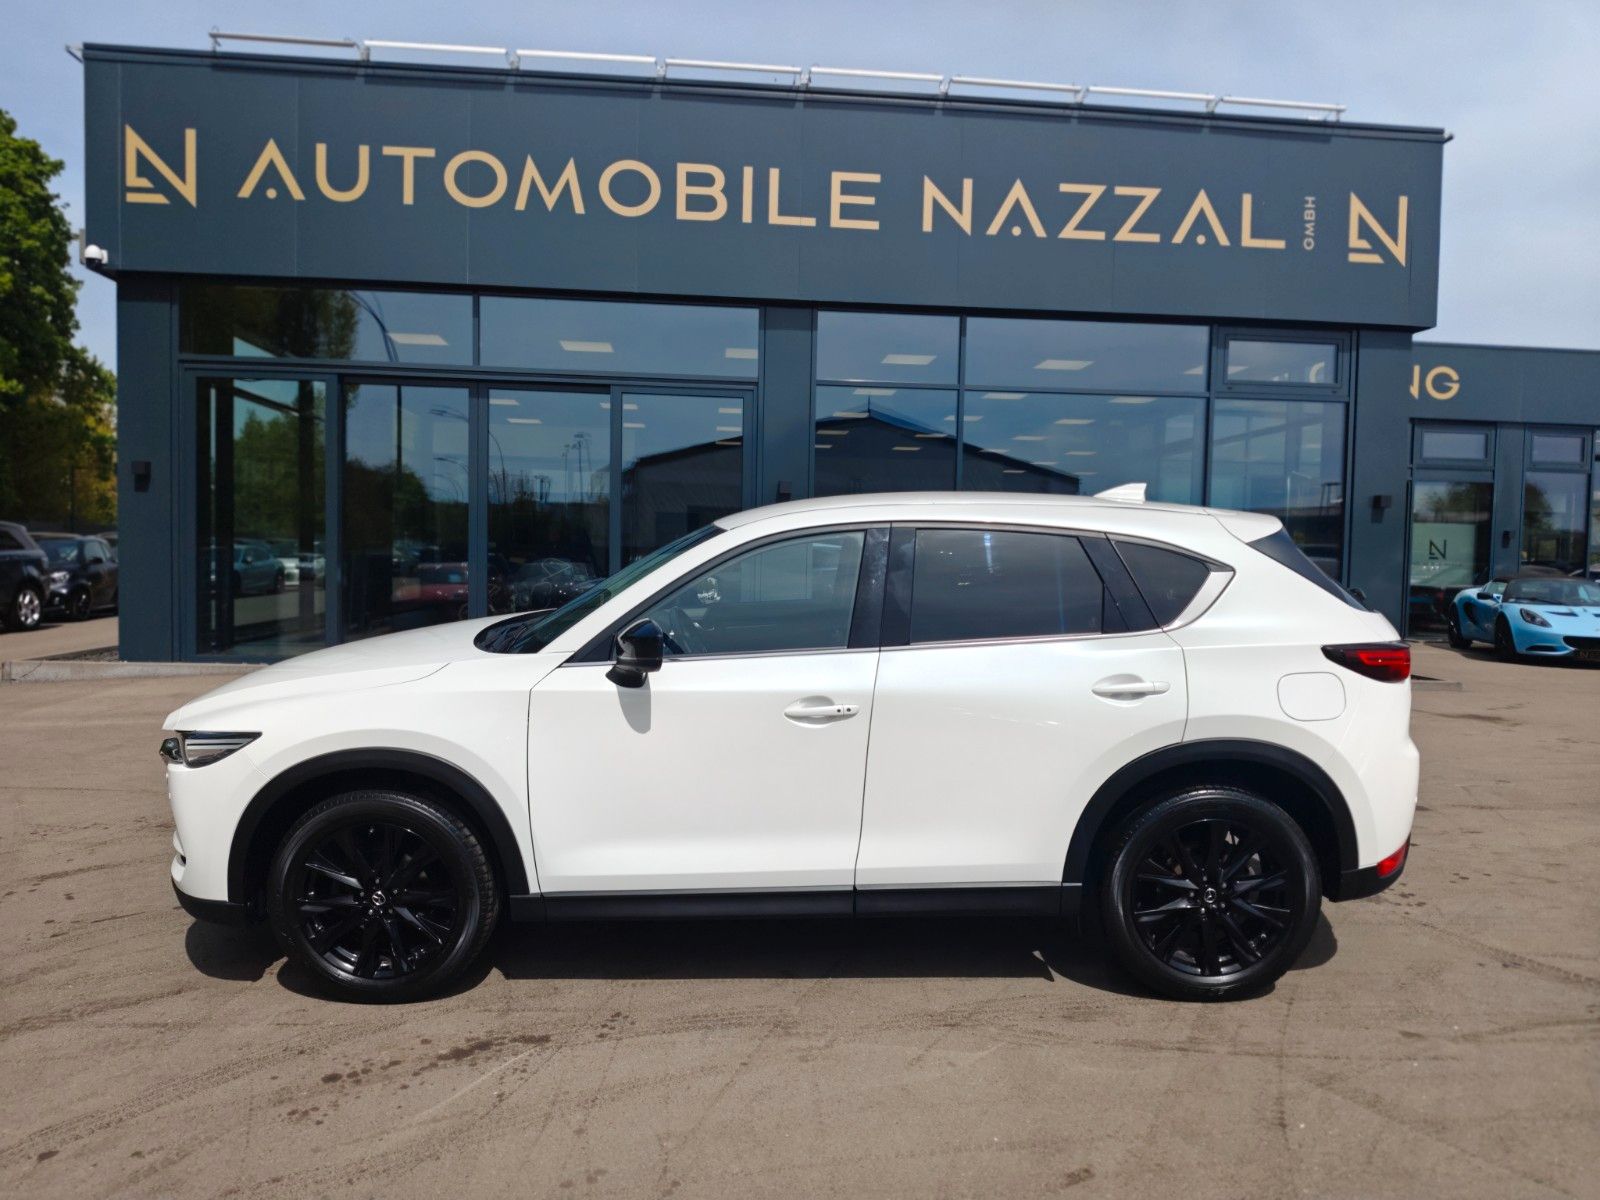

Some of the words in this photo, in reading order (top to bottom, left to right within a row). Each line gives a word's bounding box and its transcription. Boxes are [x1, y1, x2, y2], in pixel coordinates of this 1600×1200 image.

[237, 137, 882, 230] AUTOMOBILE
[922, 176, 1286, 250] NAZZAL
[1303, 195, 1316, 251] GMBH
